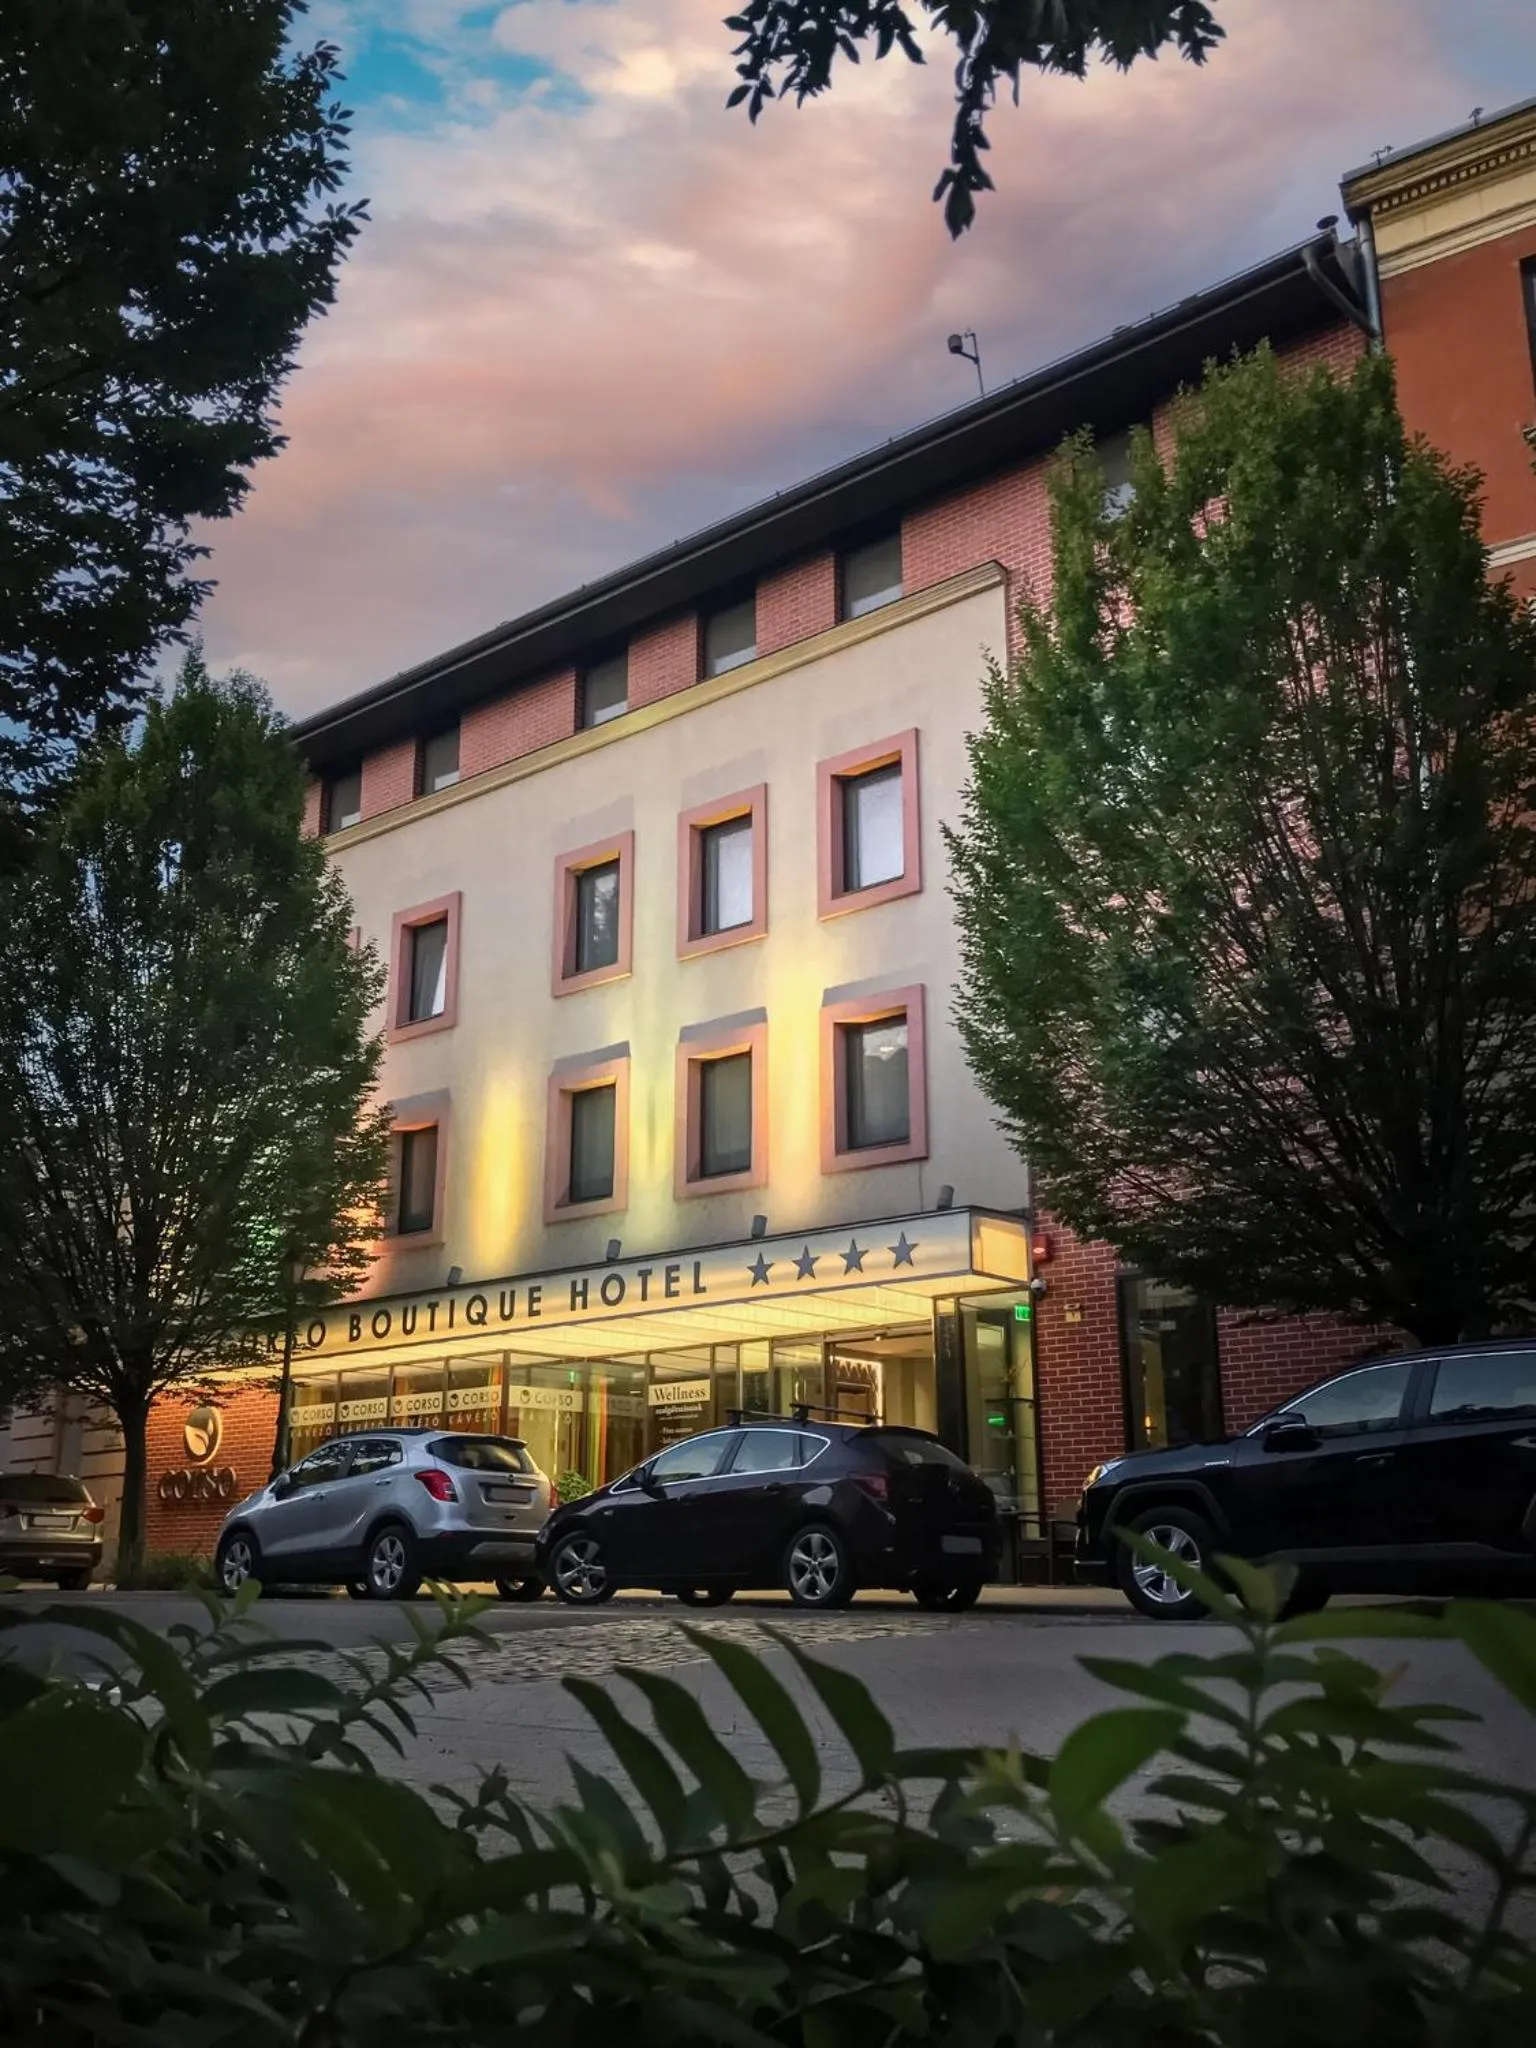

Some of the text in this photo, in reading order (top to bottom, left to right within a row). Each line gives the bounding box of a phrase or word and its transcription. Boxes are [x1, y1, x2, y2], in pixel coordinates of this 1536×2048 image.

[349, 1286, 542, 1342] BOUTIQUE
[570, 1261, 707, 1311] HOTEL
[462, 1391, 499, 1405] CORSO
[654, 1386, 706, 1401] Wellness
[353, 1402, 385, 1416] CORSO
[406, 1397, 440, 1411] CORSO
[302, 1408, 333, 1421] CORSO
